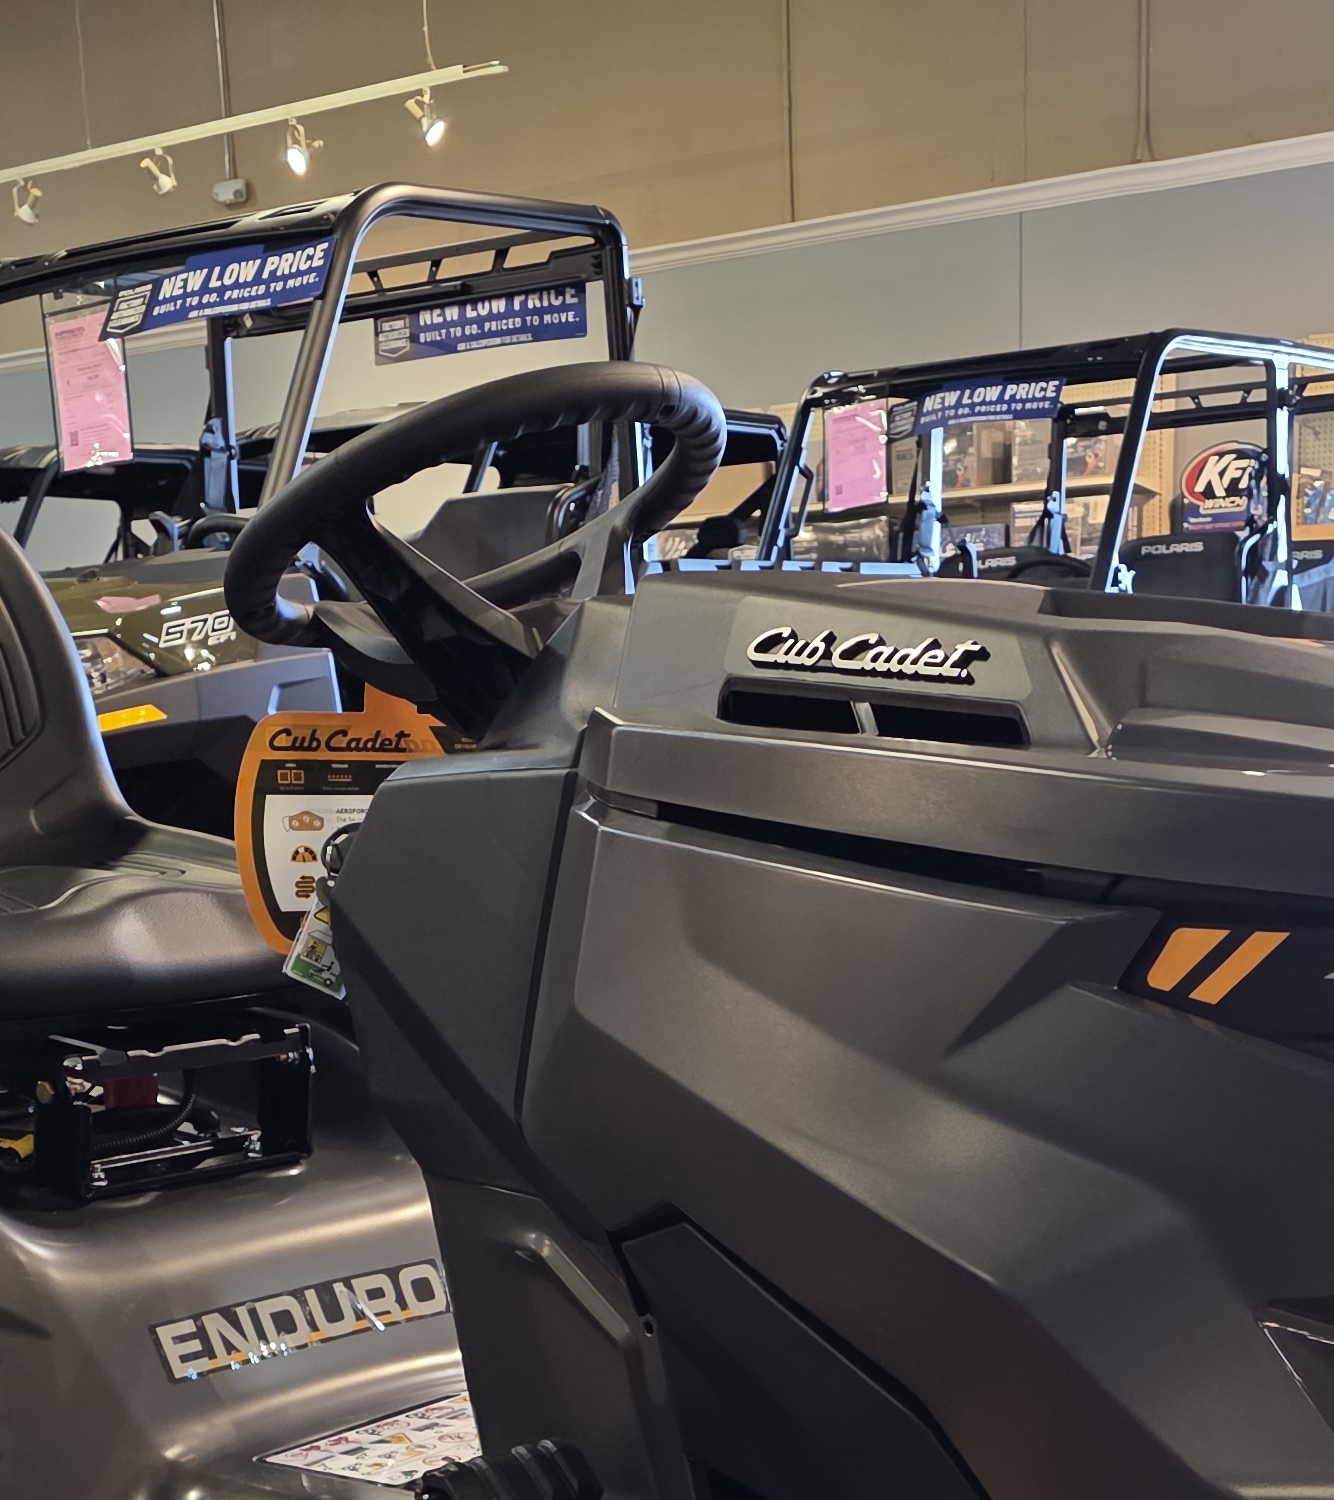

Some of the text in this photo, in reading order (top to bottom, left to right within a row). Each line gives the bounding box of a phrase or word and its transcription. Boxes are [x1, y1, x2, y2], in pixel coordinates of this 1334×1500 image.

[158, 242, 329, 300] NEW LOW PRICE
[186, 296, 199, 306] TO
[224, 284, 266, 300] PRICED
[270, 281, 283, 293] TO
[419, 287, 578, 326] NEW LOW PRICE
[450, 327, 462, 338] TO
[484, 319, 522, 333] PRICED
[525, 316, 539, 326] TO
[543, 311, 580, 325] MOVE.
[923, 380, 1060, 413] NEW LOW PRICE
[1141, 542, 1204, 555] POLARIS
[159, 610, 234, 648] 570
[747, 626, 831, 667] Cub
[268, 727, 411, 753] Cub Cadet
[155, 1264, 447, 1379] ENDURO
